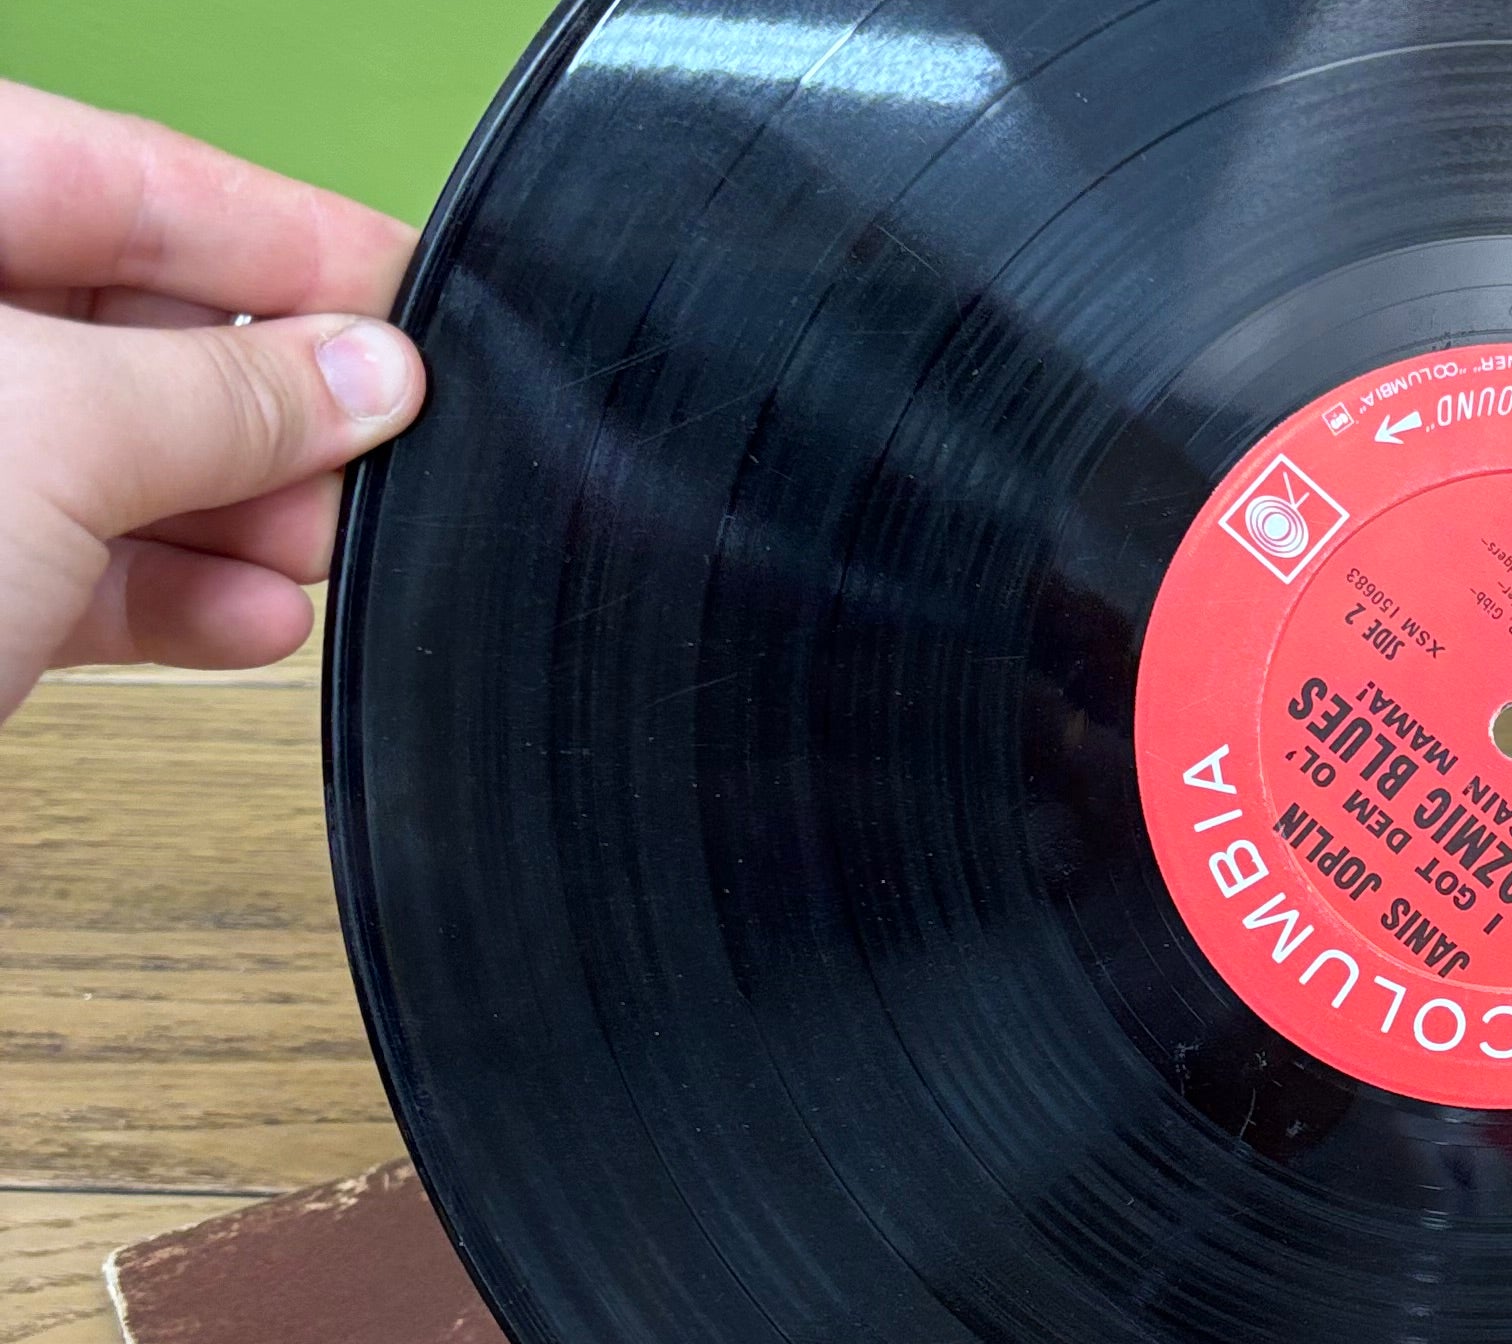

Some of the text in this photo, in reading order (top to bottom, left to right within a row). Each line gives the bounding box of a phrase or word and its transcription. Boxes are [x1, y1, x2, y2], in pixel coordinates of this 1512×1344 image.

[1344, 602, 1406, 661] SIDE 2
[1345, 567, 1446, 659] XSM 150683
[1287, 677, 1420, 802] BLUES
[1355, 680, 1459, 776] MAMA!
[1272, 801, 1471, 979] JANIS JOPLIN
[1284, 745, 1504, 936] I GOT DEM OL'
